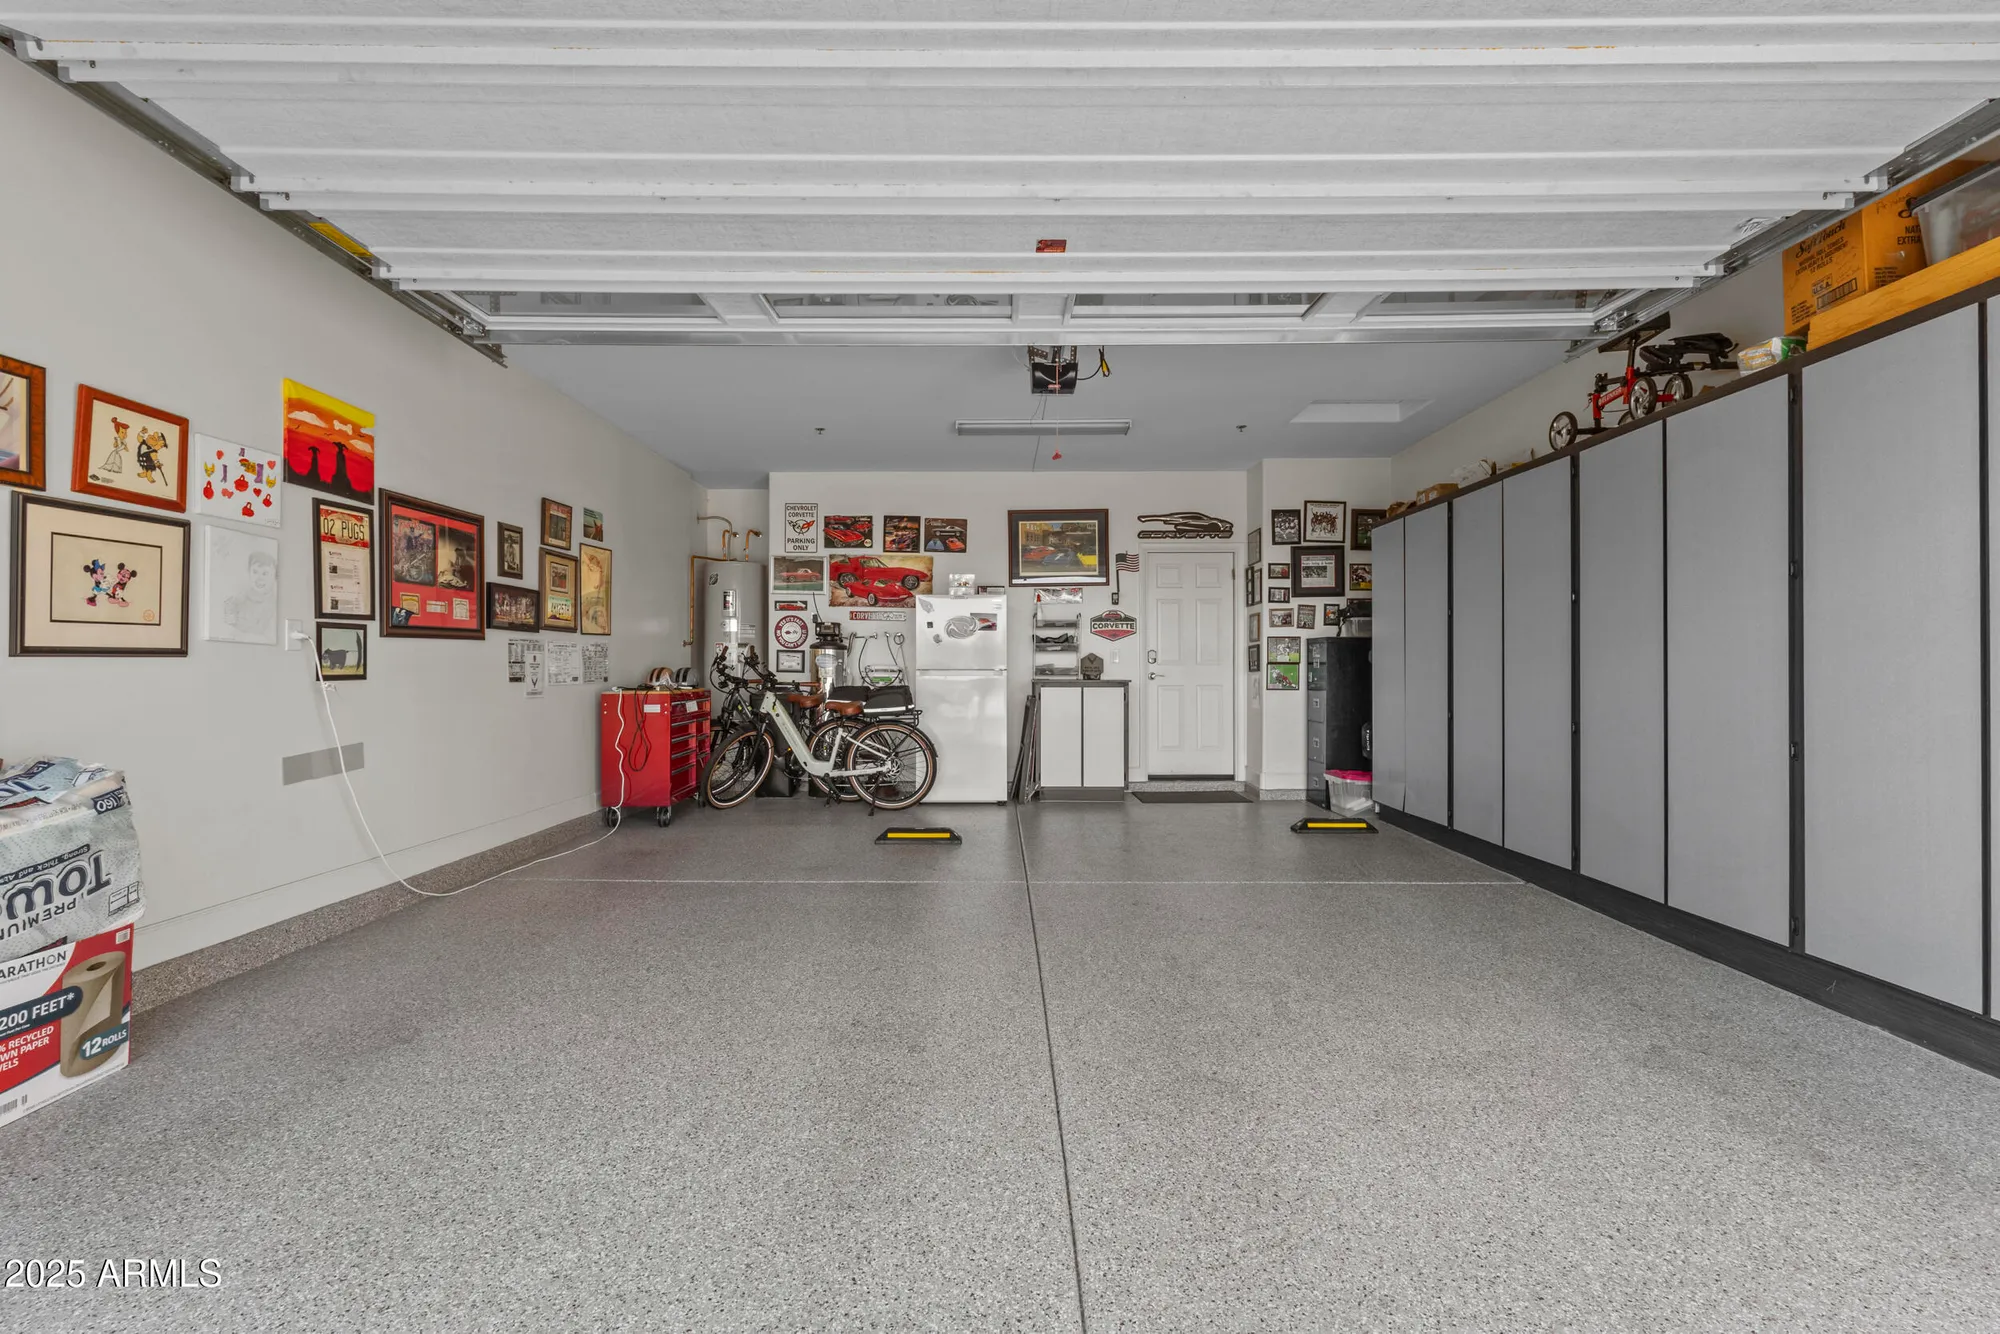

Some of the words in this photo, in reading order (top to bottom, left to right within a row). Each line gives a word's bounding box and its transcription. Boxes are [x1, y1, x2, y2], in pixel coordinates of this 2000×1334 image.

[341, 522, 365, 541] PUGS
[1092, 622, 1135, 630] CORVETTE
[97, 797, 117, 812] 160
[18, 867, 34, 878] and
[37, 858, 58, 872] Thick
[0, 854, 111, 920] TOW
[8, 1026, 54, 1049] RECYCLED
[82, 1037, 101, 1056] 12
[102, 1029, 127, 1047] ROLLS
[0, 1048, 18, 1062] WN
[20, 1037, 49, 1054] PAPER
